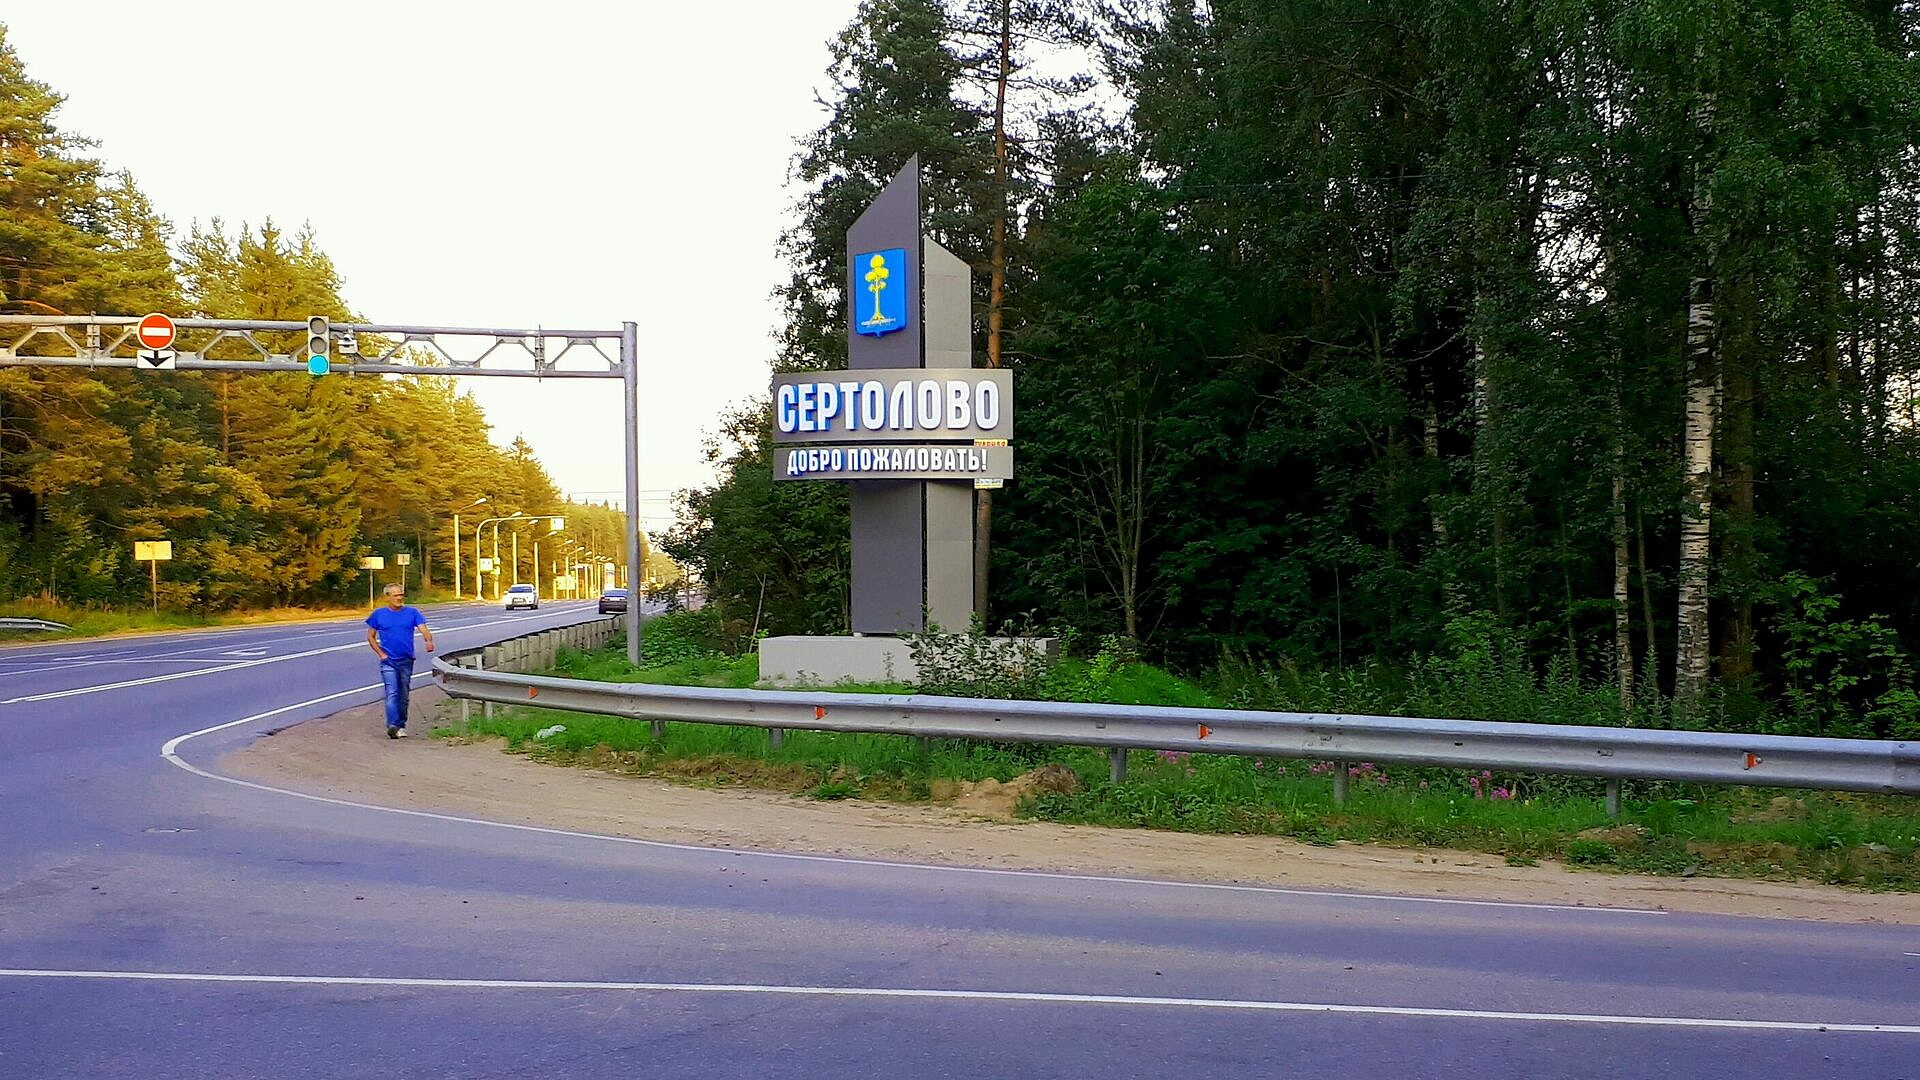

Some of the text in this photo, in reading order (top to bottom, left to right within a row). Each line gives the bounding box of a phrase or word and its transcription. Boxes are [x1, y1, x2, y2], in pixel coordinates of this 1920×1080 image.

[777, 380, 1000, 432] СЕРТОЛОВО
[787, 448, 988, 475] ДОБРО ПОЖАЛОВАТЬ!
